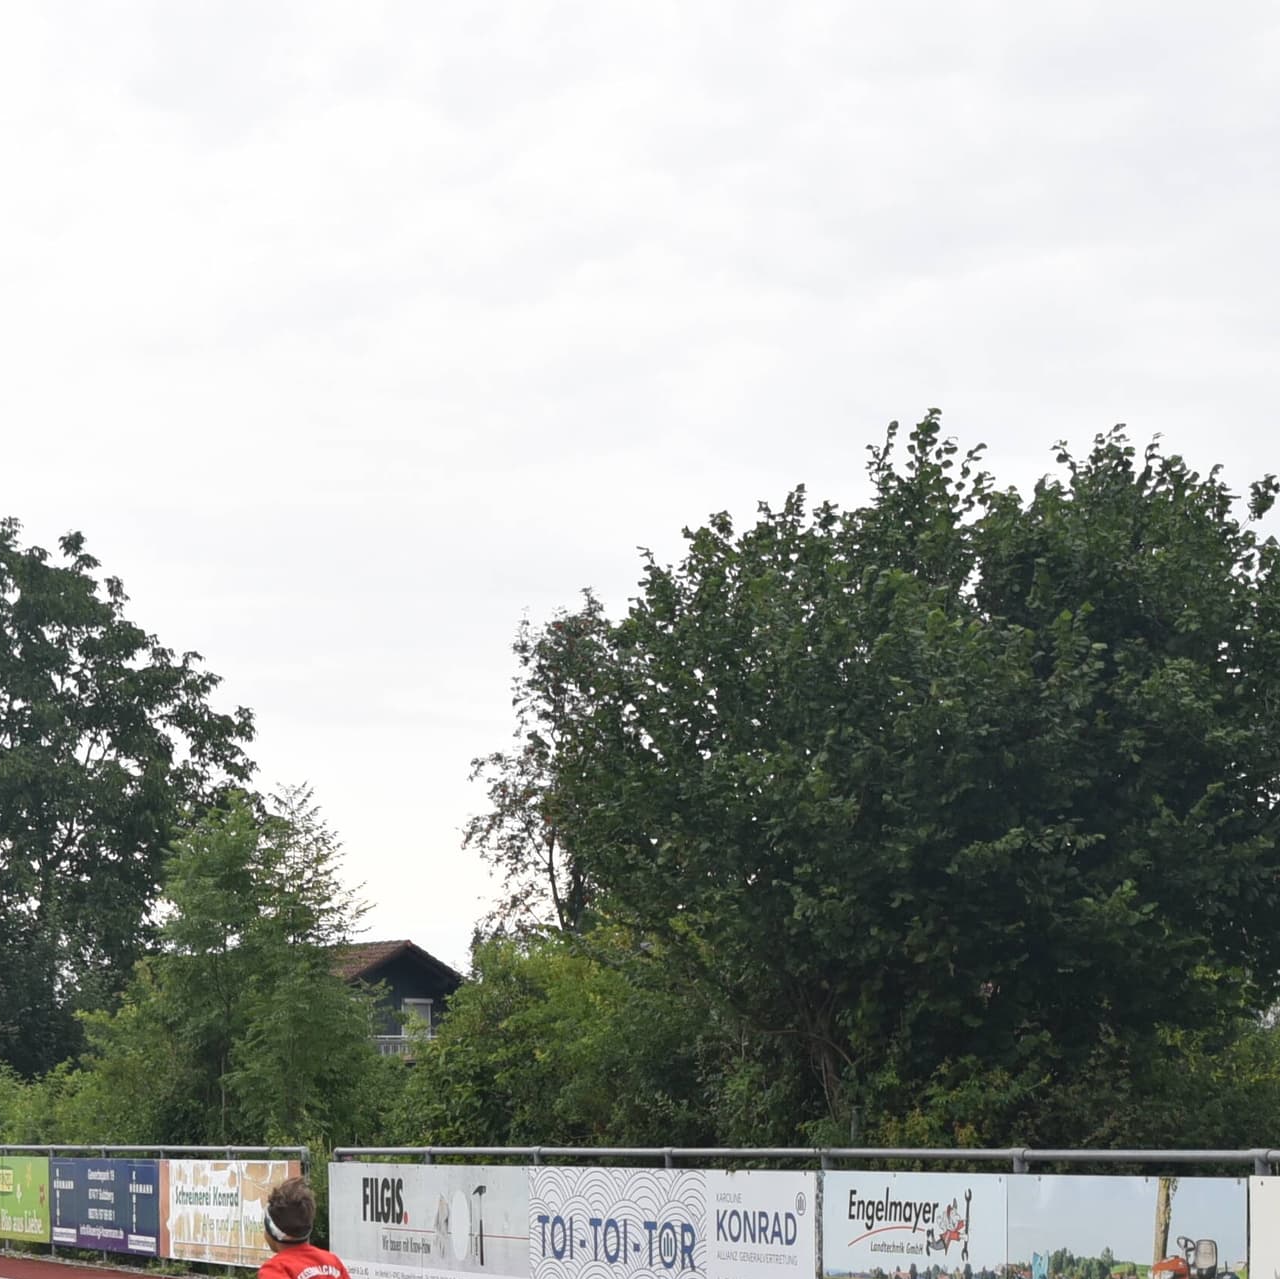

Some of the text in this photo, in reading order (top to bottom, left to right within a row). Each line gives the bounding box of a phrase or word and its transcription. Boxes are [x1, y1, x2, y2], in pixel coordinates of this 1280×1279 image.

[175, 1185, 239, 1207] Schreinerei Konrad
[848, 1186, 939, 1234] Engelmayer
[716, 1208, 797, 1246] KONRAD
[870, 1240, 924, 1255] Landtechnik GmbH
